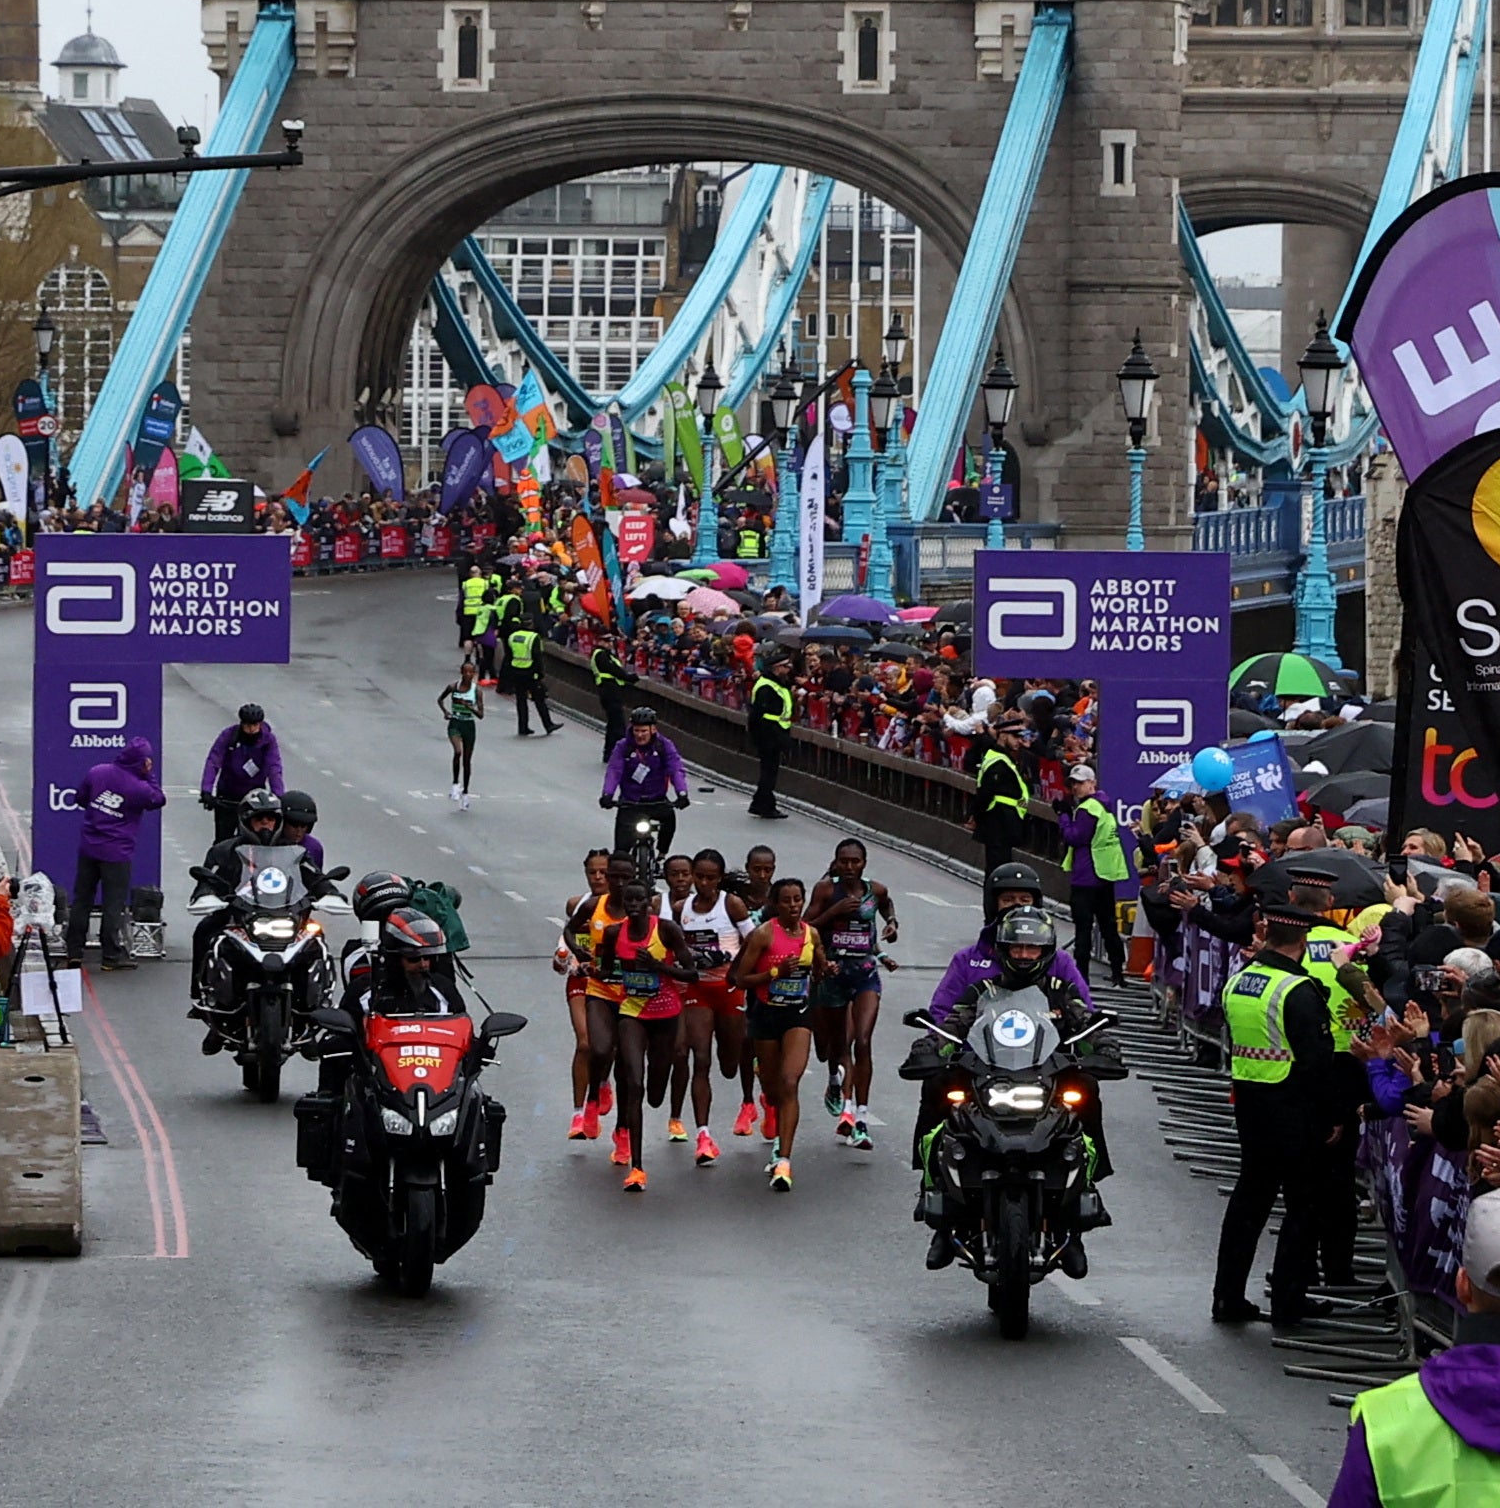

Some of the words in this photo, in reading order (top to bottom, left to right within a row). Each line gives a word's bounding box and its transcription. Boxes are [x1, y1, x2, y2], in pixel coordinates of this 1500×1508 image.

[188, 513, 206, 522] new
[207, 512, 244, 523] balance
[625, 521, 647, 530] KEEP
[625, 532, 647, 542] LEFT!
[149, 563, 236, 580] ABBOTT
[149, 581, 229, 598] WORLD
[1090, 579, 1177, 596] ABBOTT
[149, 600, 280, 617] MARATHON
[1090, 597, 1169, 614] WORLD
[149, 619, 242, 635] MAJORS
[1090, 616, 1220, 634] MARATHON
[1090, 634, 1183, 652] MAJORS
[70, 734, 126, 748] Abbott
[1137, 751, 1192, 764] Abbott
[1421, 726, 1499, 809] tc
[49, 783, 86, 811] tc
[1117, 799, 1143, 827] tc
[1239, 974, 1269, 994] POLICE
[401, 1045, 440, 1057] BBC
[398, 1057, 442, 1069] SPORT
